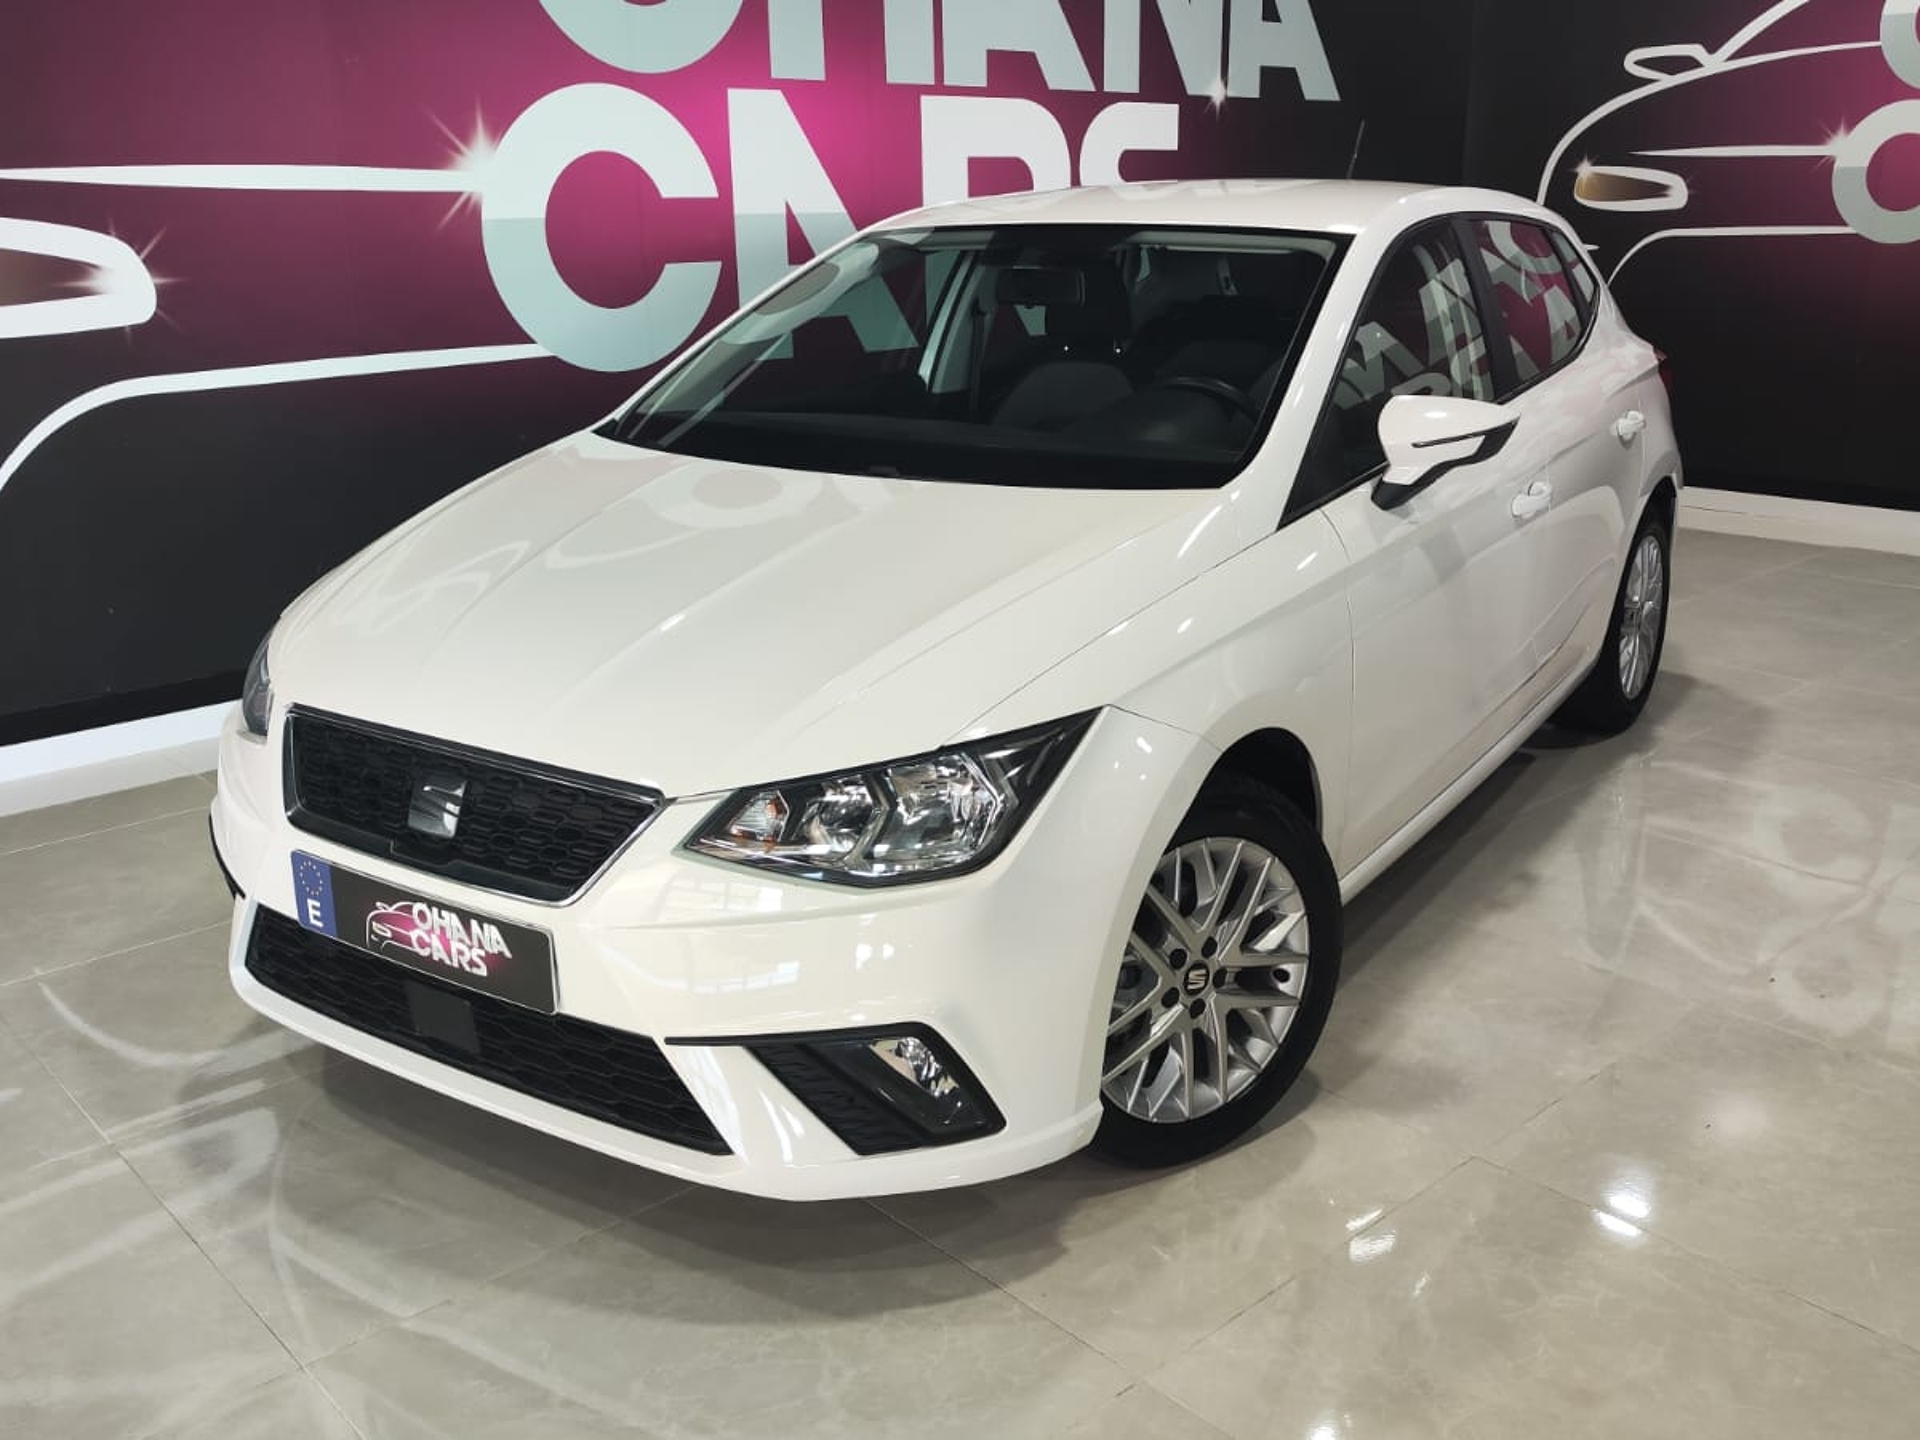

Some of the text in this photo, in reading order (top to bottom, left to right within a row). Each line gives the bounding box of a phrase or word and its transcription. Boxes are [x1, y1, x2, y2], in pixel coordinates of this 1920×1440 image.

[306, 898, 324, 929] E
[412, 902, 513, 959] OHANA
[410, 928, 488, 977] CARS
